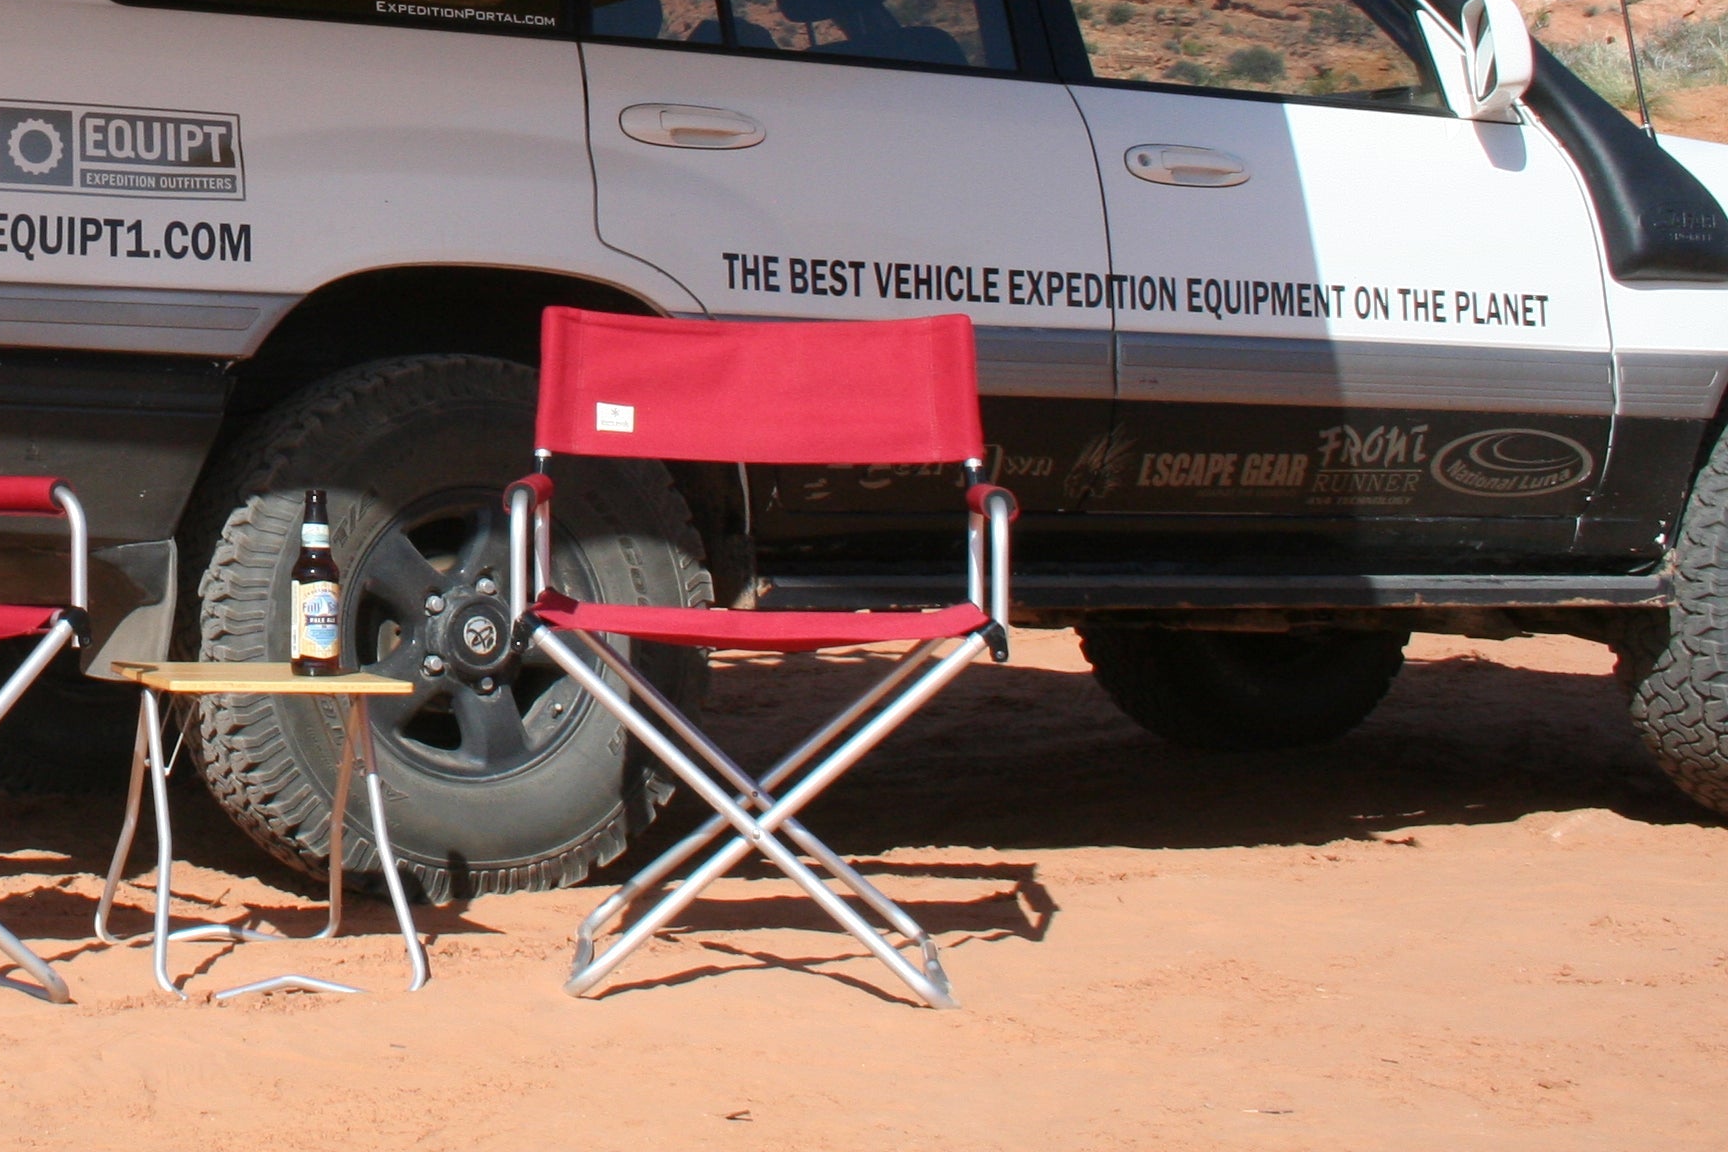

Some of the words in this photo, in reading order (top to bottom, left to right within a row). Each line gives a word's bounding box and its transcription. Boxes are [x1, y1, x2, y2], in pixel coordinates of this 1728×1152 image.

[84, 117, 228, 164] EQUIPT
[85, 172, 156, 189] EXPEDITION
[159, 174, 233, 191] OUTFITTERS
[722, 252, 780, 292] THE
[789, 257, 865, 297] BEST
[873, 261, 1000, 303] VEHICLE
[1008, 269, 1176, 311] EXPEDITION
[1186, 278, 1345, 320] EQUIPMENT
[1354, 286, 1390, 320] ON
[1397, 288, 1447, 323] THE
[1454, 291, 1548, 327] PLANET
[1318, 423, 1431, 467] FRONT
[1136, 452, 1238, 487] ESCAPE
[1240, 452, 1309, 487] GEAR
[1312, 473, 1421, 493] RUNNER
[1445, 458, 1517, 491] National
[1518, 467, 1572, 491] Luna
